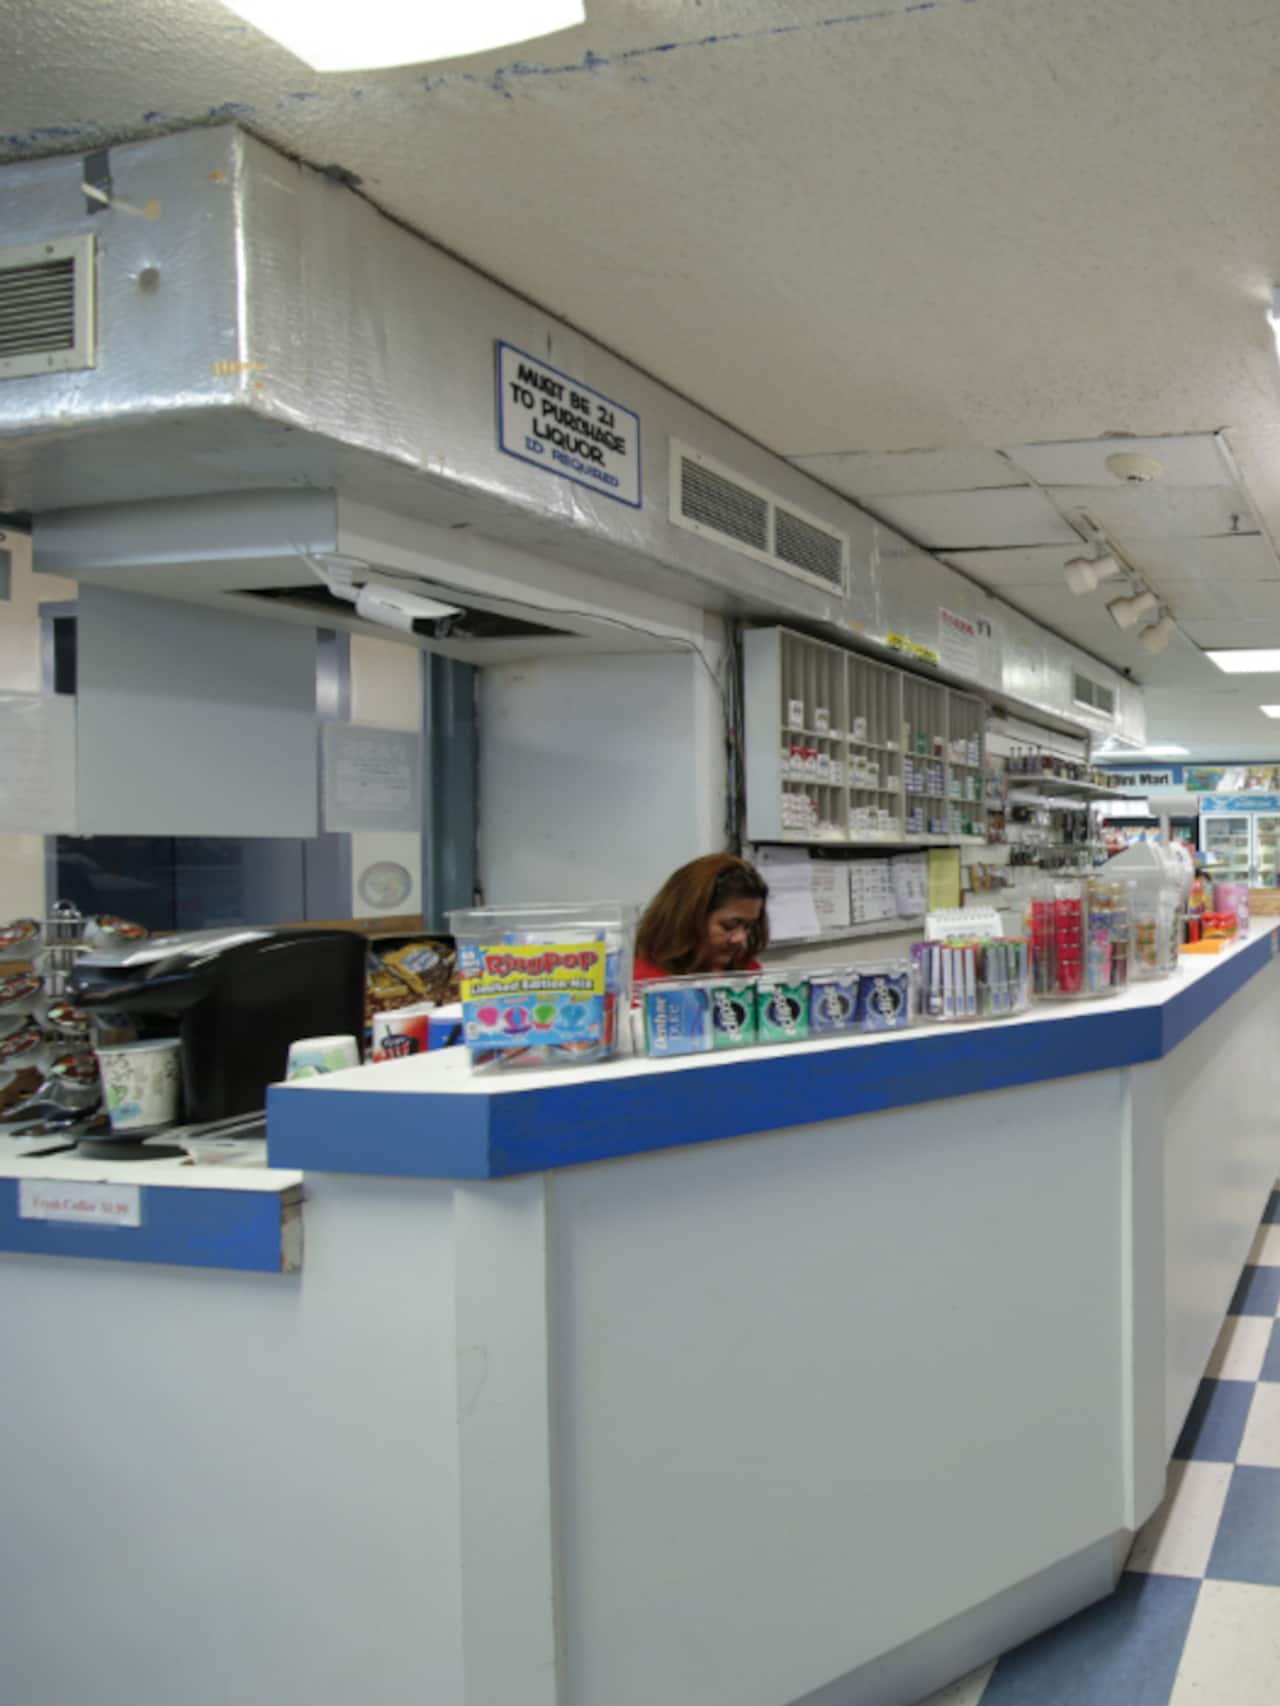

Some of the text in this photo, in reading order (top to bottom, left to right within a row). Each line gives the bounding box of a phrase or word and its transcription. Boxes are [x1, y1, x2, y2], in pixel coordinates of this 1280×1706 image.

[509, 382, 626, 455] TO PURCHASE
[517, 363, 615, 429] MUST BE 21
[525, 436, 620, 487] ID REQUIRED
[533, 417, 606, 467] LIQUOR
[1139, 773, 1169, 785] Mart
[471, 981, 519, 996] Limited
[522, 979, 566, 991] Edition
[773, 986, 798, 1036] eclipse
[874, 977, 897, 1026] eclipse
[714, 990, 743, 1041] eclipse
